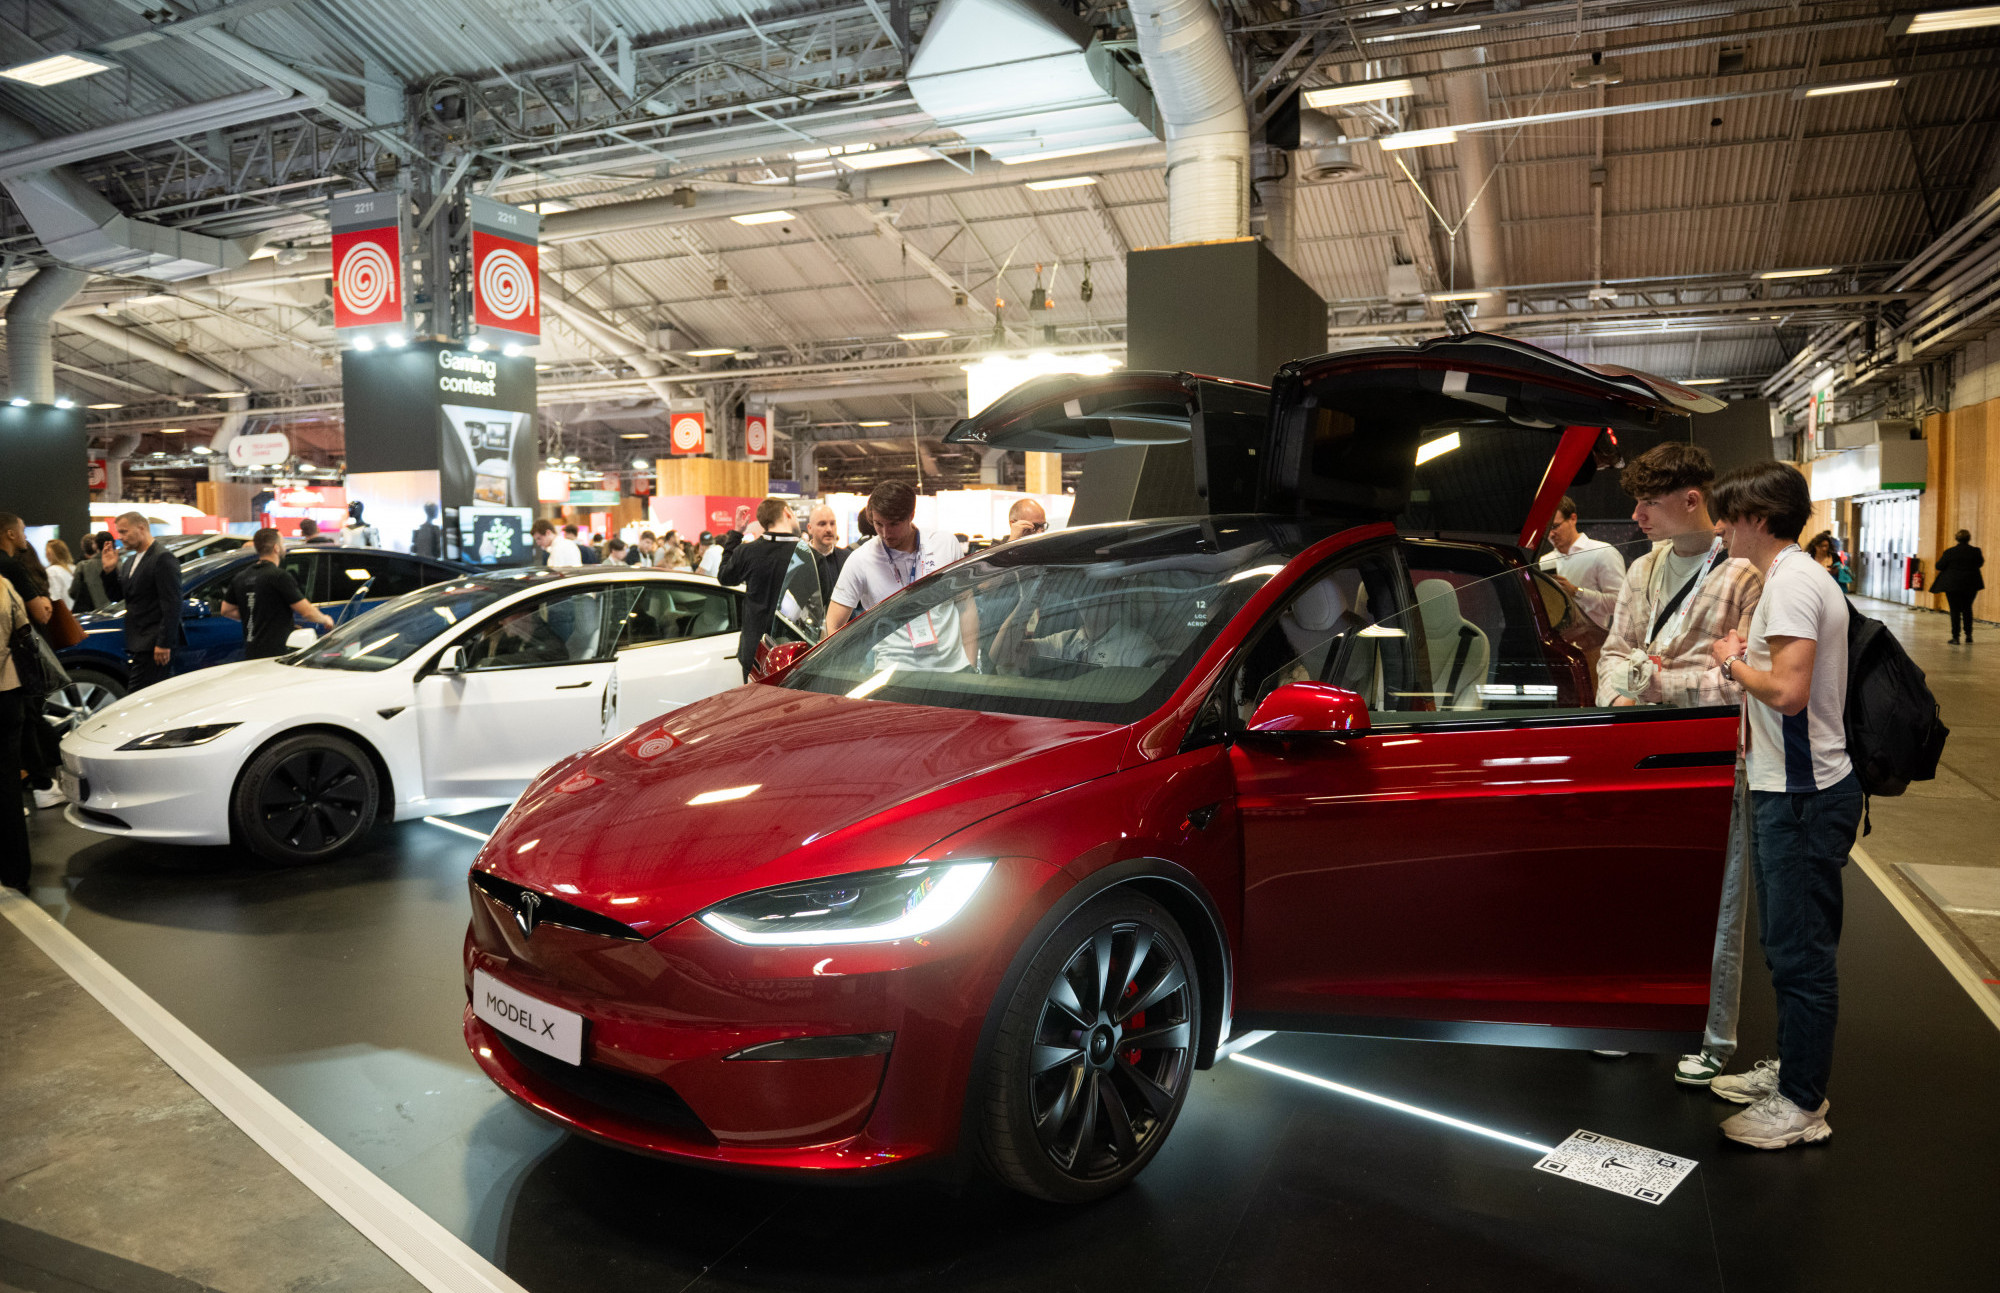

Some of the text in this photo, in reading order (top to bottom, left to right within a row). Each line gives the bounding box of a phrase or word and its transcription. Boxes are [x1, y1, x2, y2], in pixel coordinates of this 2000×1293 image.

[354, 202, 374, 214] 2211
[497, 211, 517, 224] 2211
[438, 349, 497, 379] Gaming
[440, 376, 497, 397] contest
[486, 991, 555, 1041] MODEL X
